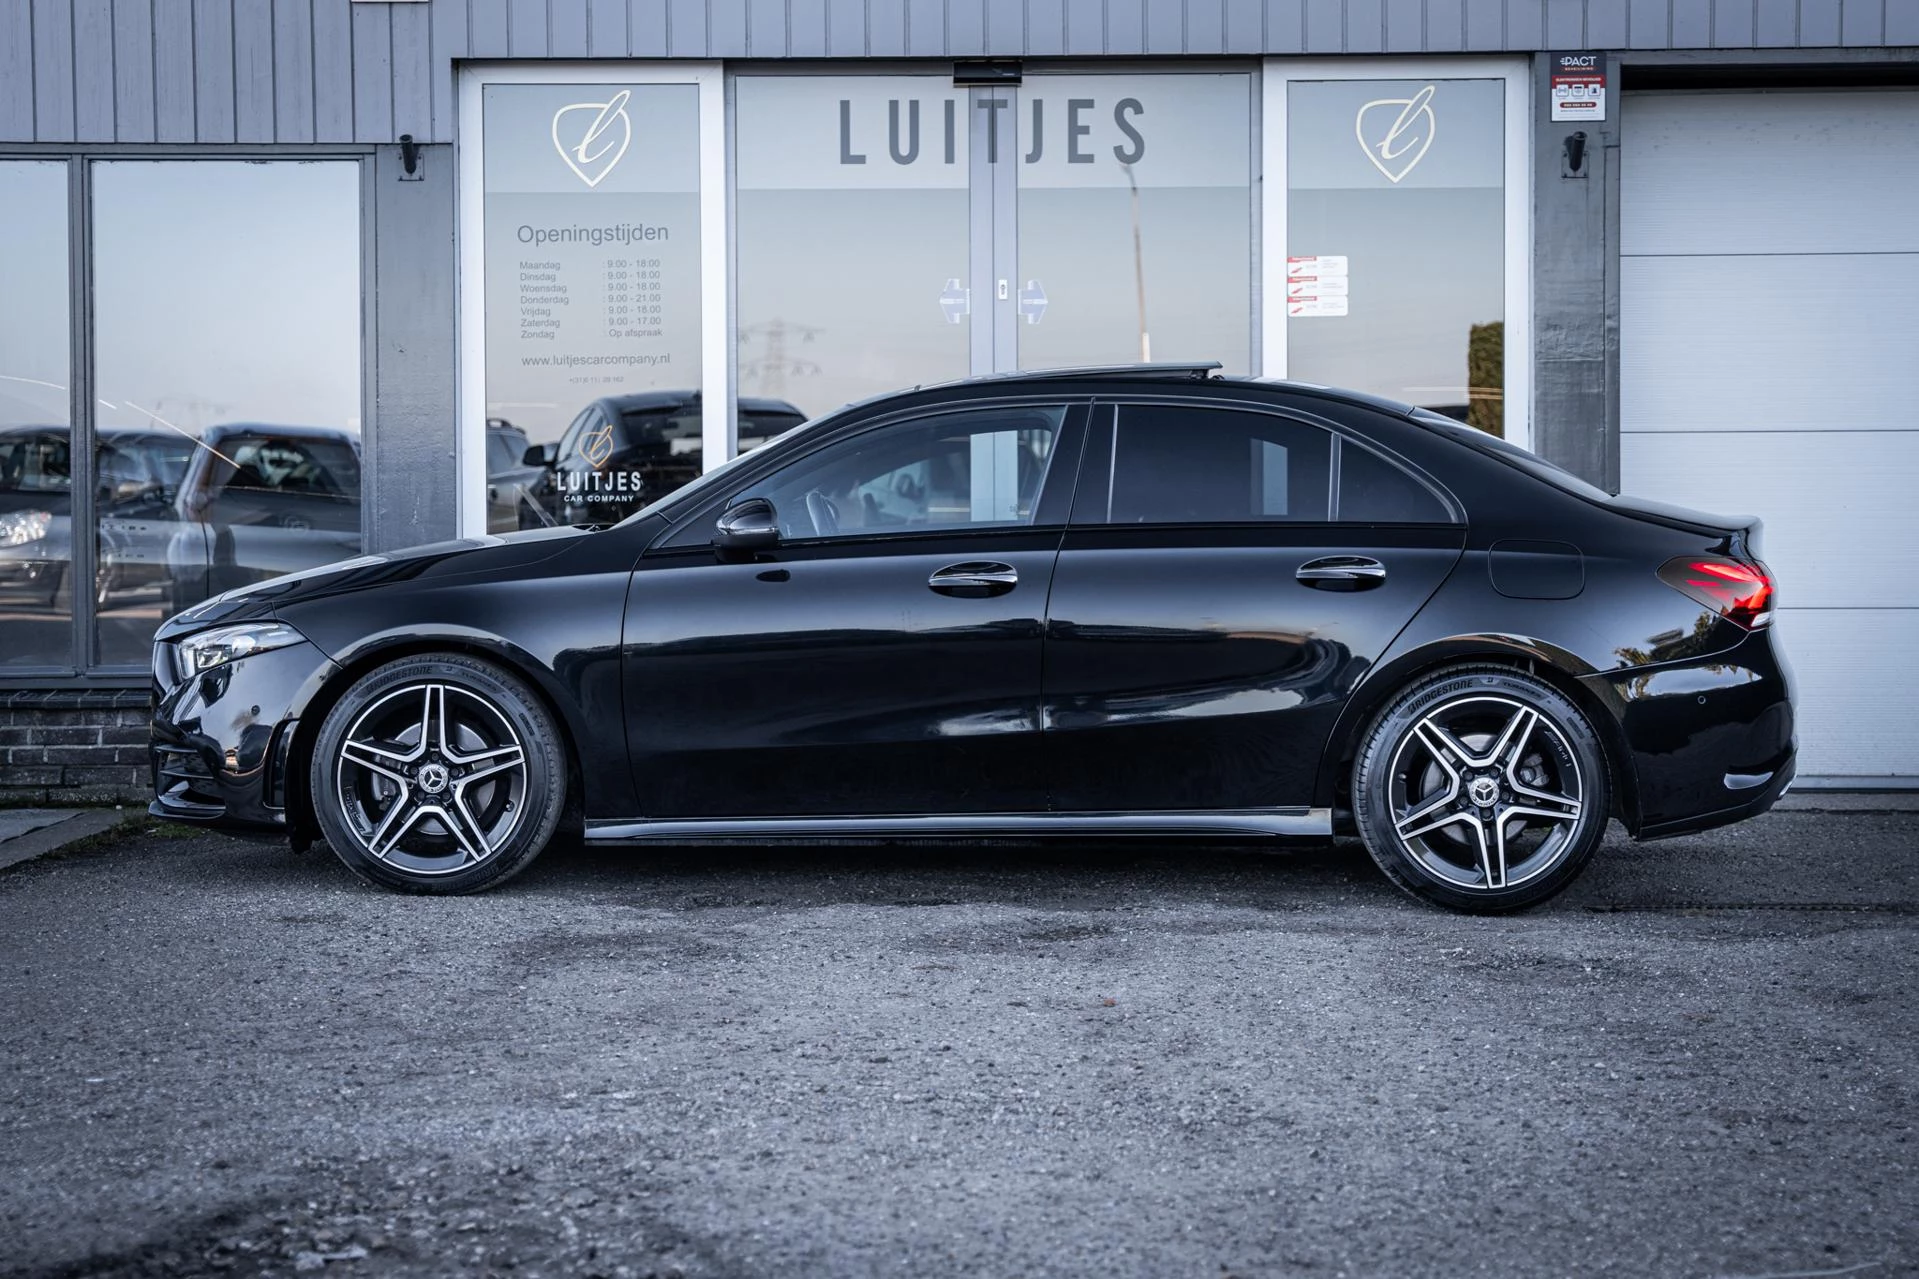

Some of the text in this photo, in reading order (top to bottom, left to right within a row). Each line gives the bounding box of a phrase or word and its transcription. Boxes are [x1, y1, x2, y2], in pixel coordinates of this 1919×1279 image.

[839, 97, 1146, 166] LUITJES
[517, 223, 669, 247] Openingstijden
[519, 261, 561, 271] Maandag
[519, 272, 557, 283] Dinsdag
[519, 284, 568, 294] Woensdag
[520, 295, 570, 305] Donderdag
[520, 307, 552, 318] Vrijdag
[520, 318, 561, 329] Zaterdag
[520, 328, 664, 340] Zondag Op afspraak
[521, 353, 671, 368] www.luitjescarcompany.nl
[556, 471, 642, 491] LUITJES
[1407, 680, 1473, 714] BRIDGESTONE
